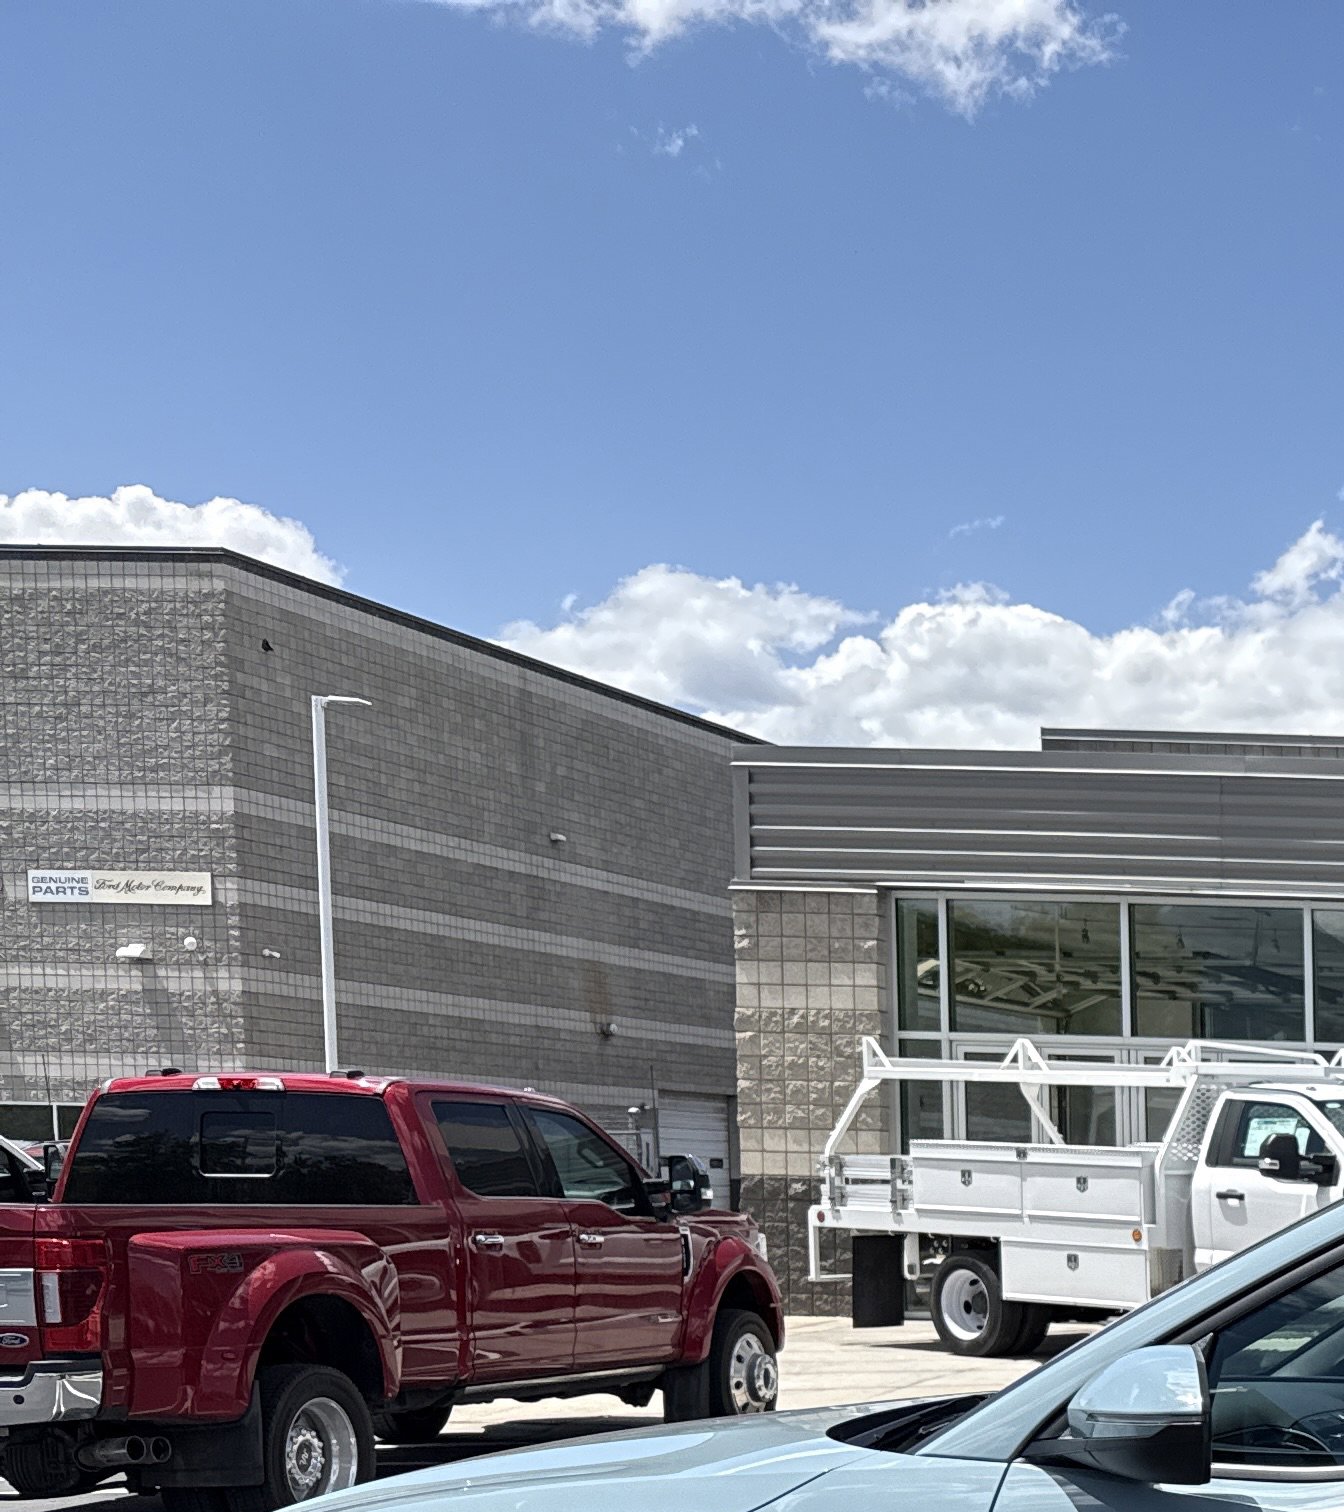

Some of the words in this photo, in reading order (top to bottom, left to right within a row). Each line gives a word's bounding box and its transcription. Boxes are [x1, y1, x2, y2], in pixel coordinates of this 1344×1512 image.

[31, 876, 89, 885] GENUINE
[94, 878, 119, 891] Ford
[119, 879, 151, 894] Motor
[31, 885, 90, 896] PARTS
[188, 1252, 244, 1274] FX4
